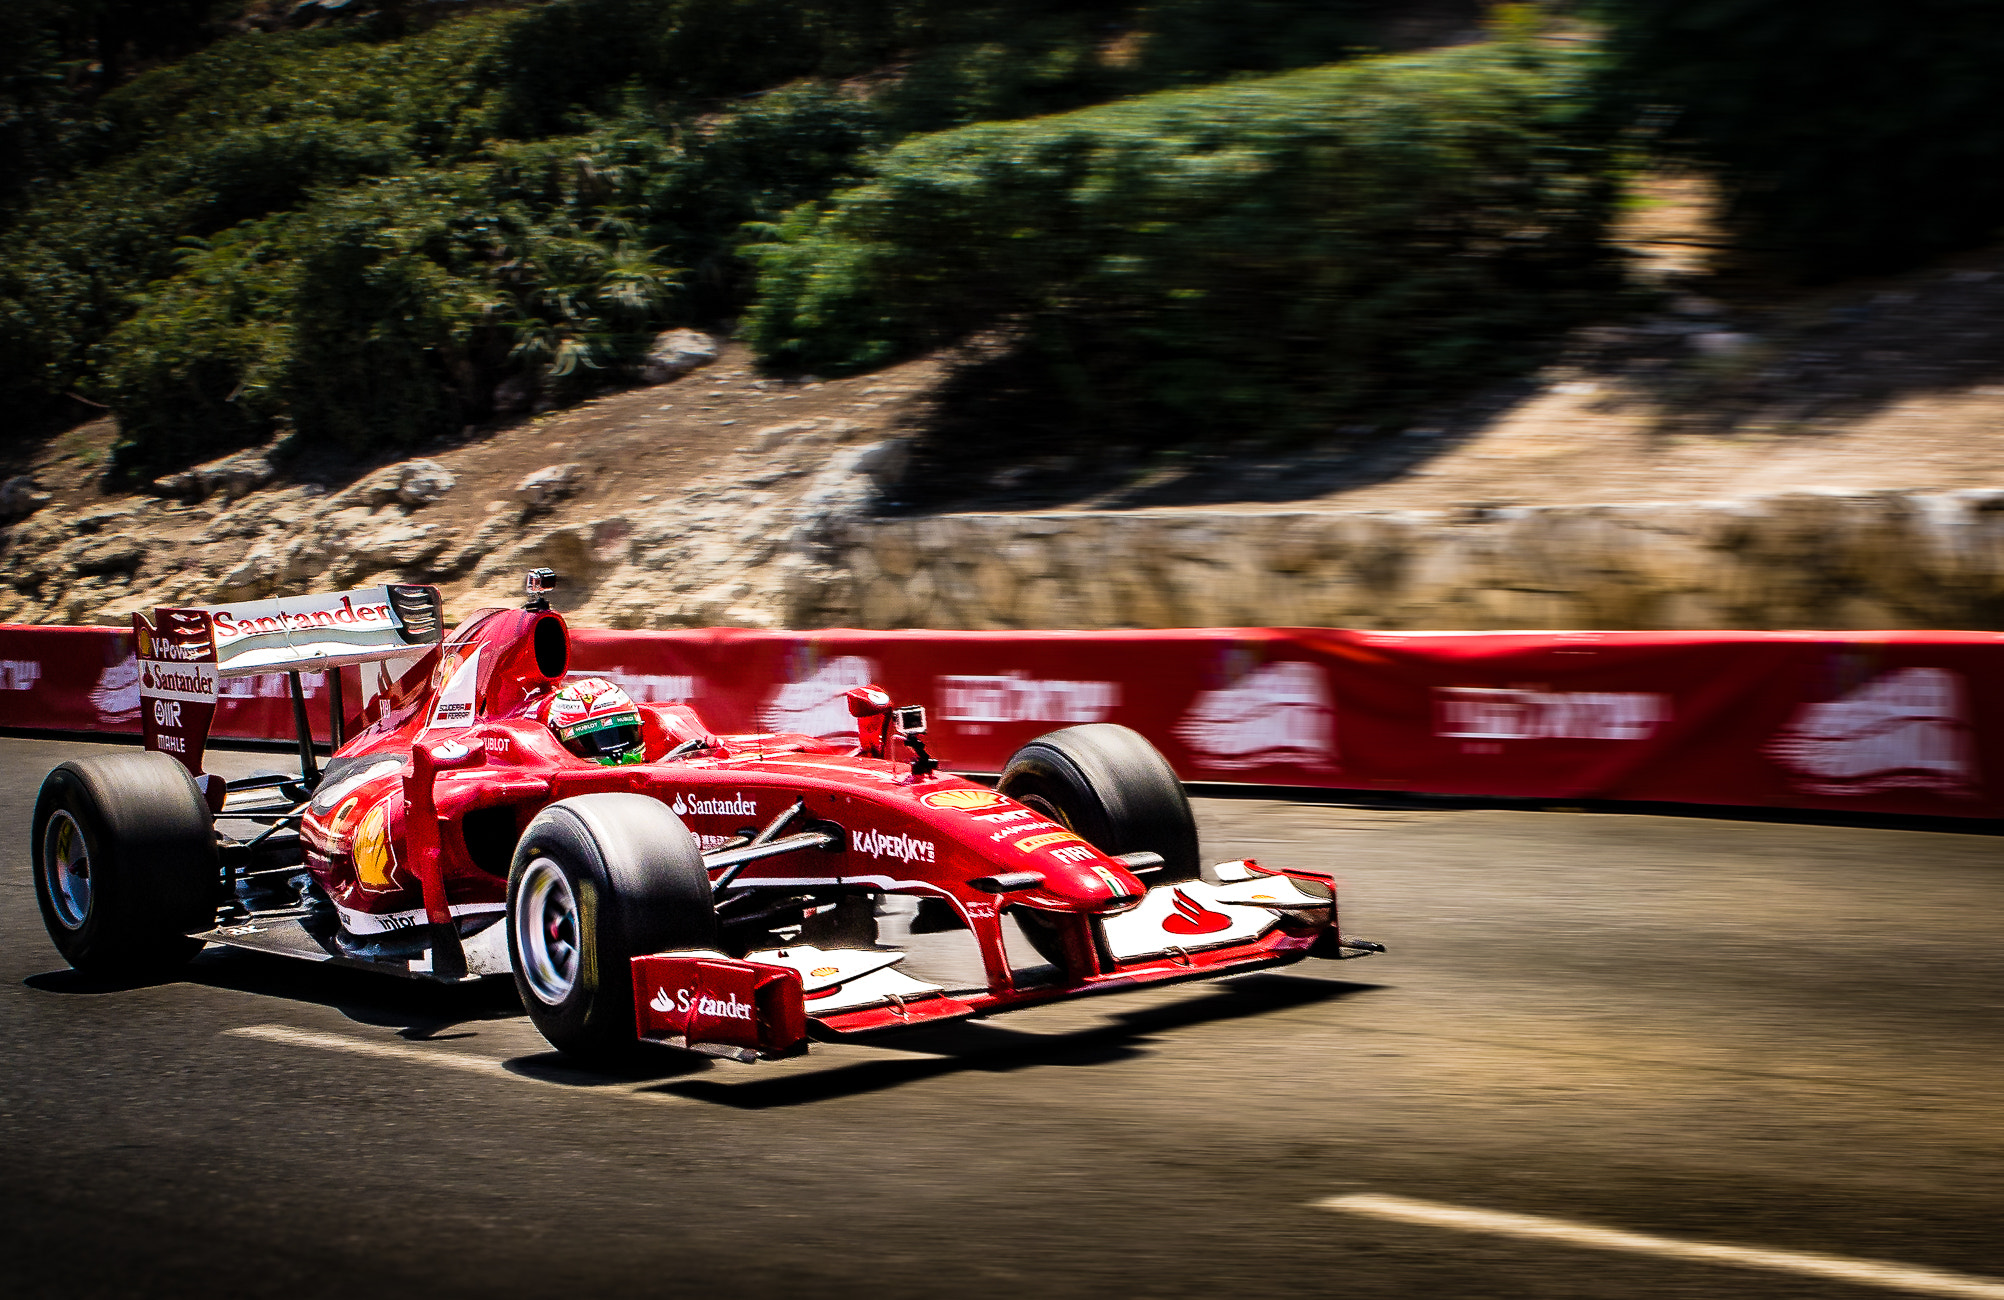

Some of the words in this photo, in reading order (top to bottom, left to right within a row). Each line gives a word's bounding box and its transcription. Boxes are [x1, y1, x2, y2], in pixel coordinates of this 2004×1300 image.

[213, 595, 391, 637] Santander
[155, 664, 213, 694] Santander
[157, 734, 186, 753] MAHLE
[688, 792, 757, 816] Santander
[852, 828, 927, 864] KASPERSKY
[1048, 845, 1098, 864] FIAT
[375, 914, 416, 931] infor
